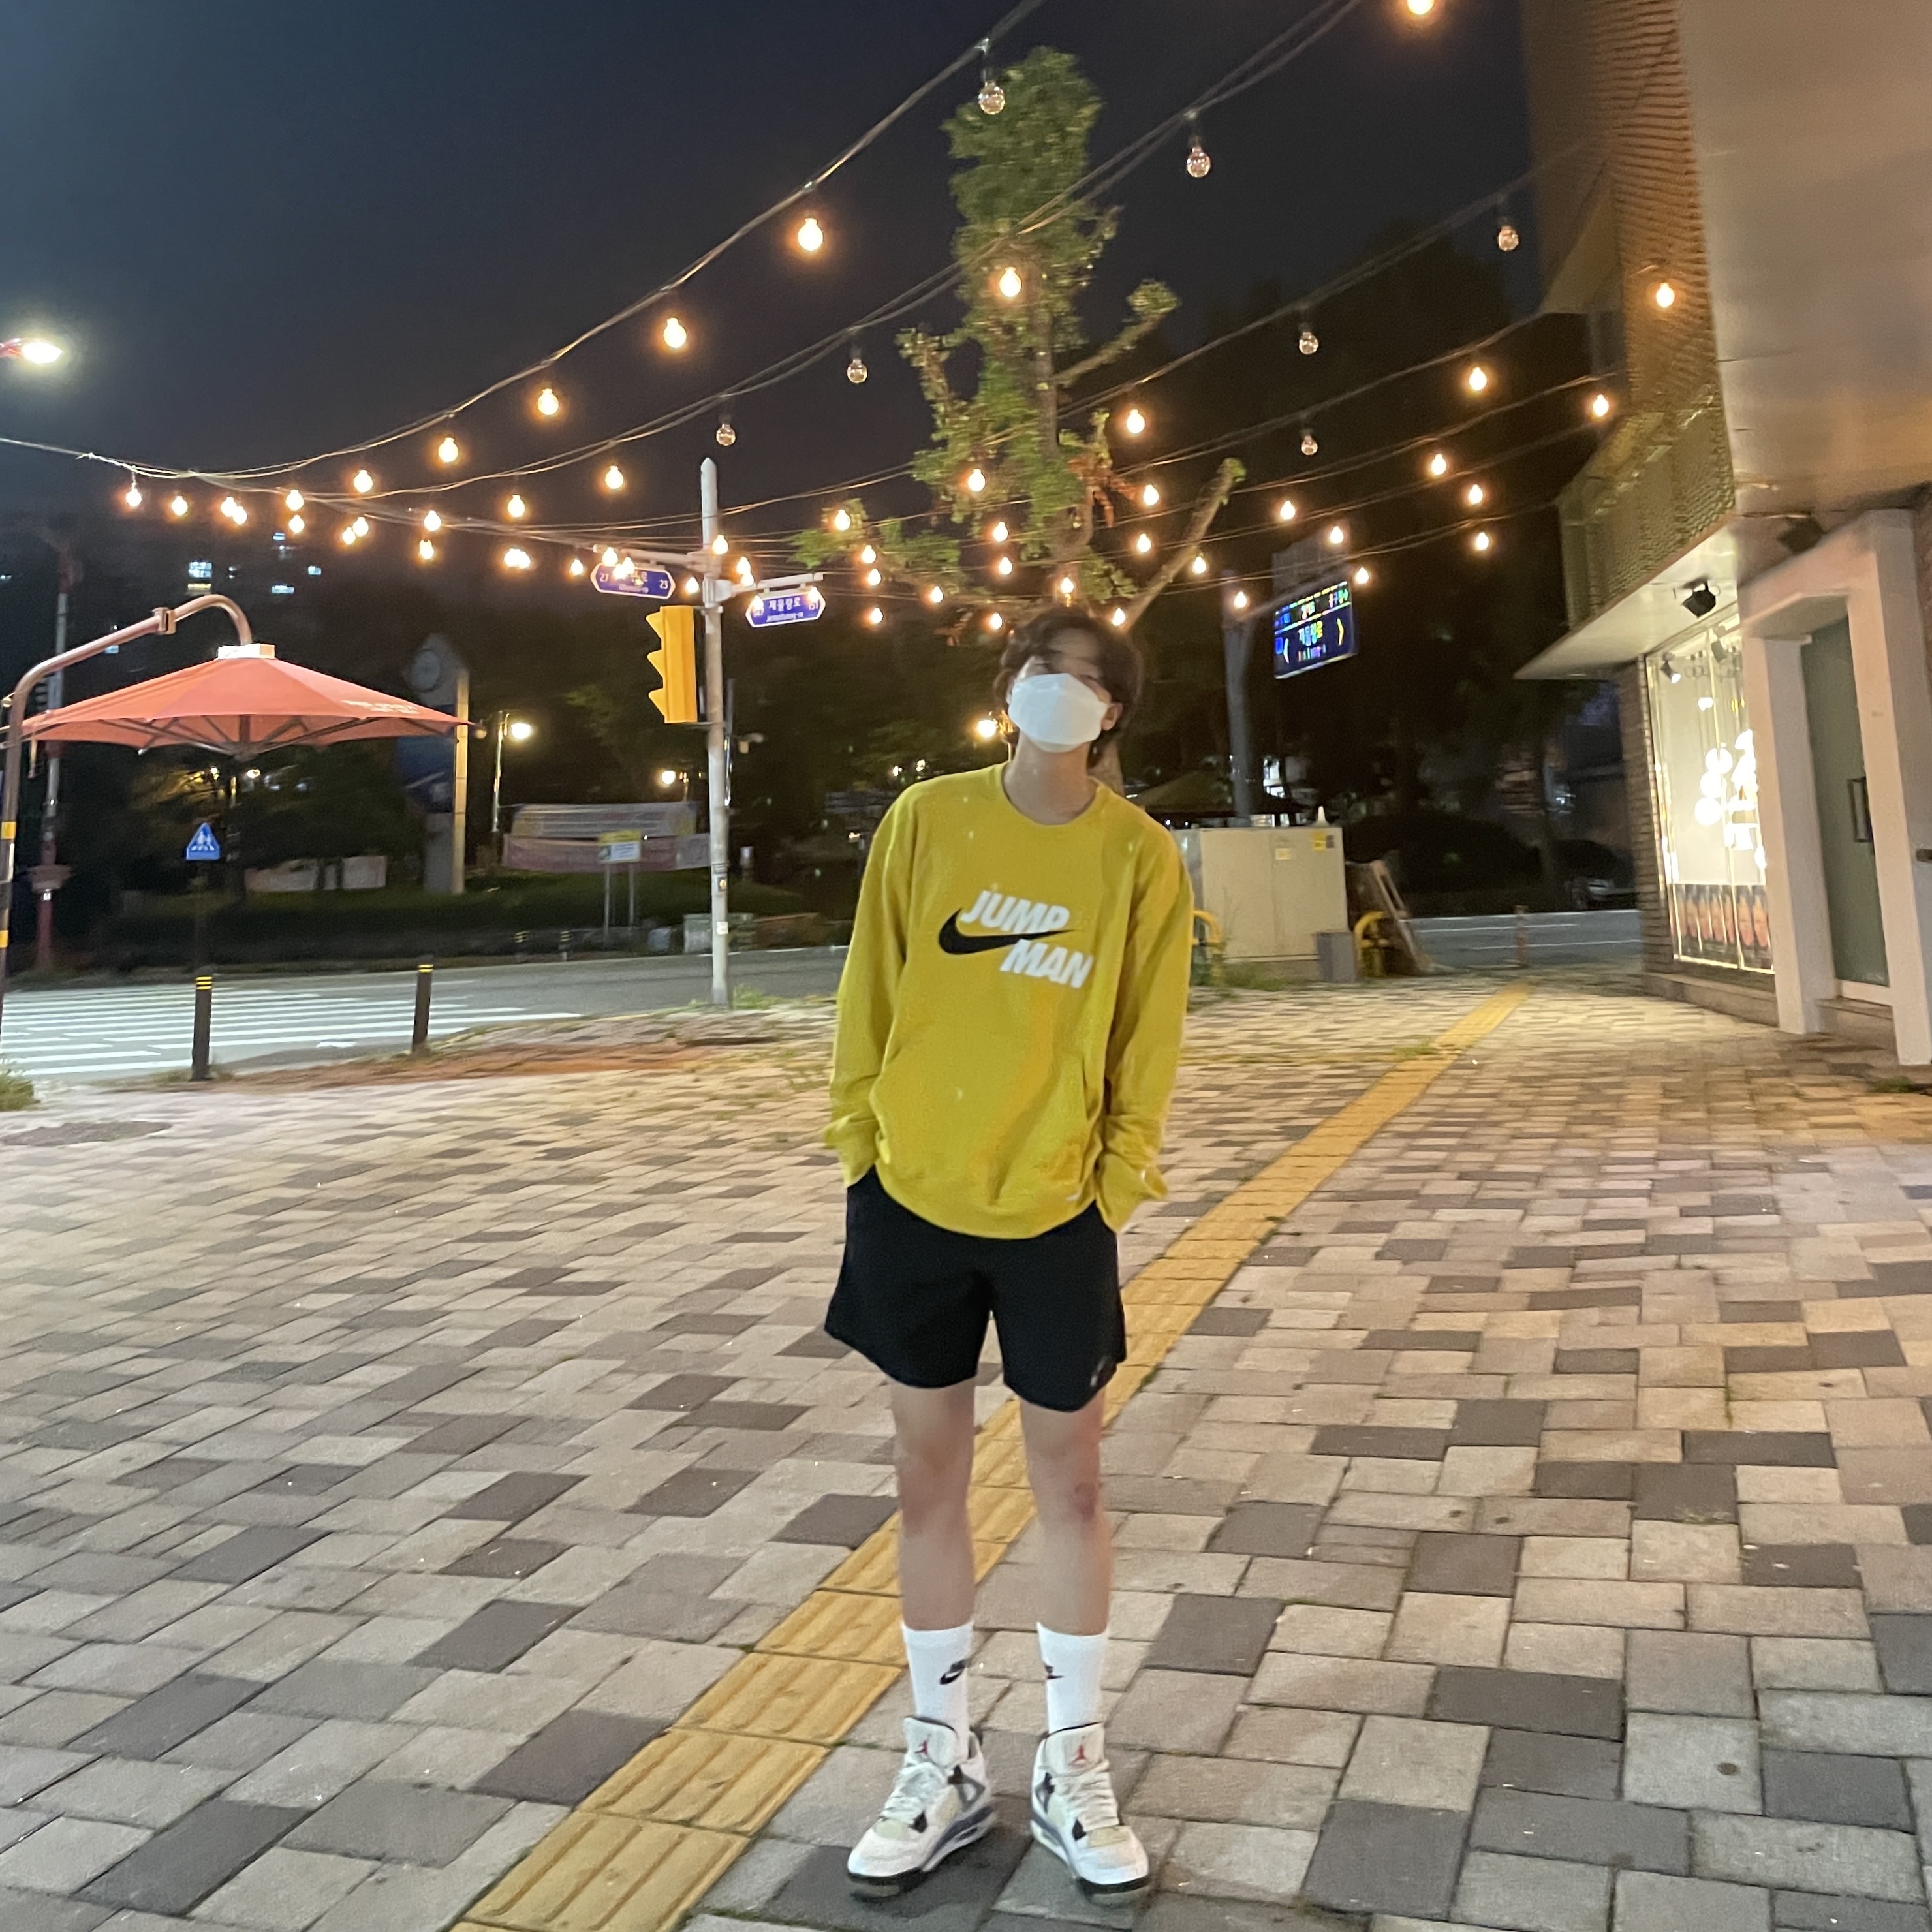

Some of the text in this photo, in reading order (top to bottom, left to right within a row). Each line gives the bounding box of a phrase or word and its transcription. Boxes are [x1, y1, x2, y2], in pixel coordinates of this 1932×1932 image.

[599, 573, 609, 582] 27
[960, 890, 1070, 933] JUMP
[1000, 939, 1093, 989] MAN
